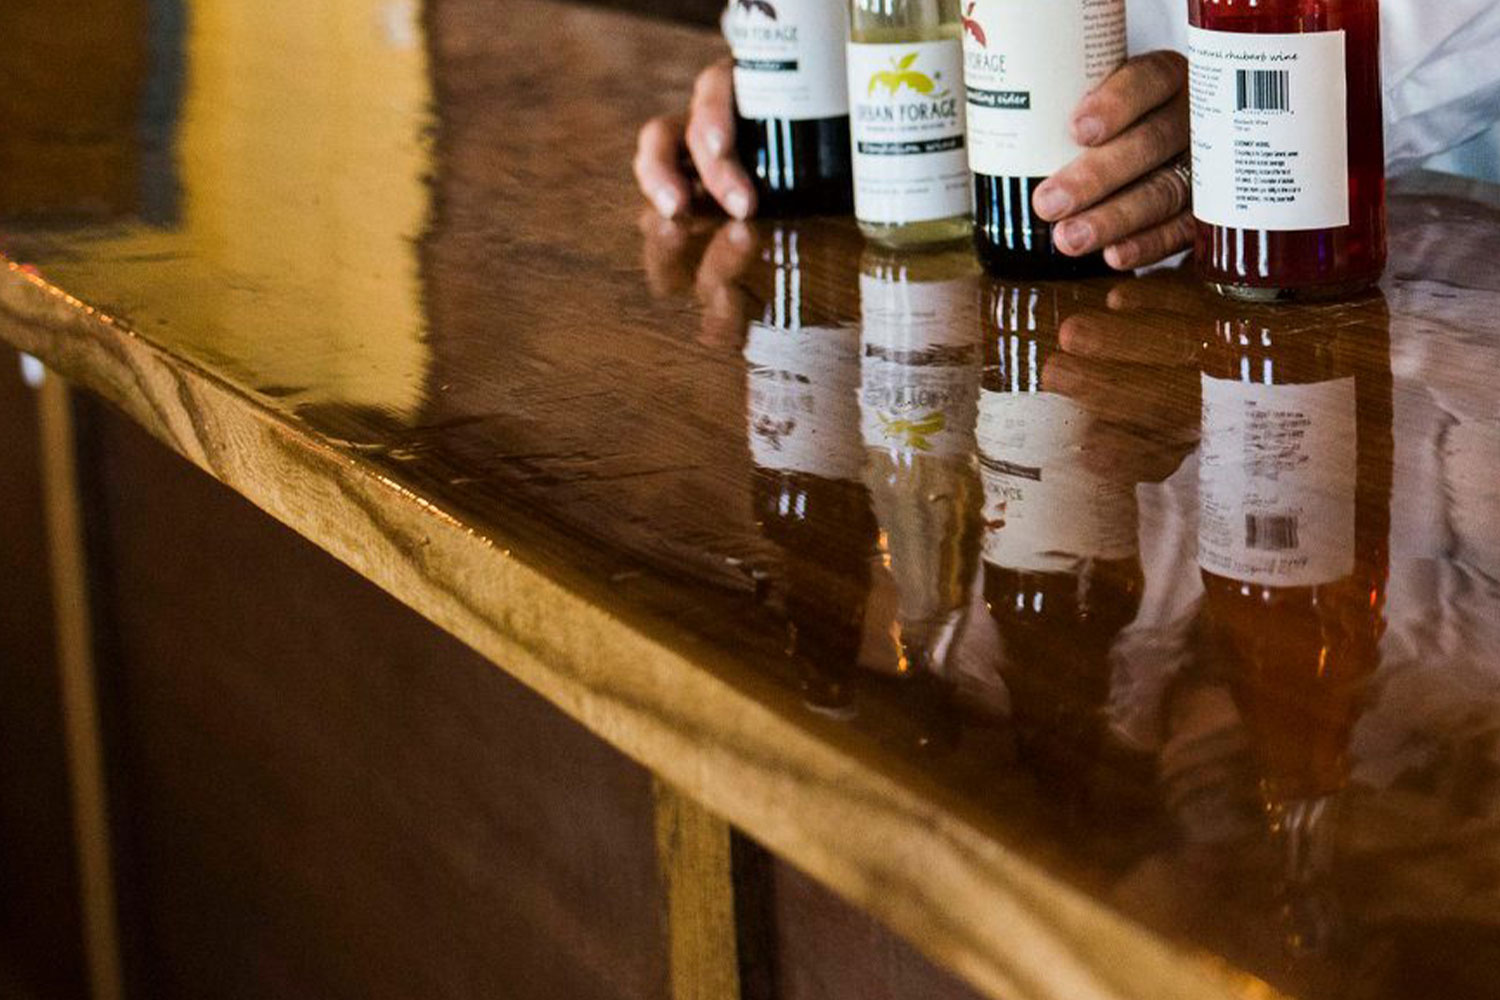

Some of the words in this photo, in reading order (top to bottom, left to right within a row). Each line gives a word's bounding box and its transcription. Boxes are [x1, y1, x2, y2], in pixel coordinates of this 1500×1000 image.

[1225, 50, 1267, 62] rhubarb
[1270, 52, 1298, 62] wine
[997, 93, 1027, 105] cider
[899, 99, 957, 121] FORAGE
